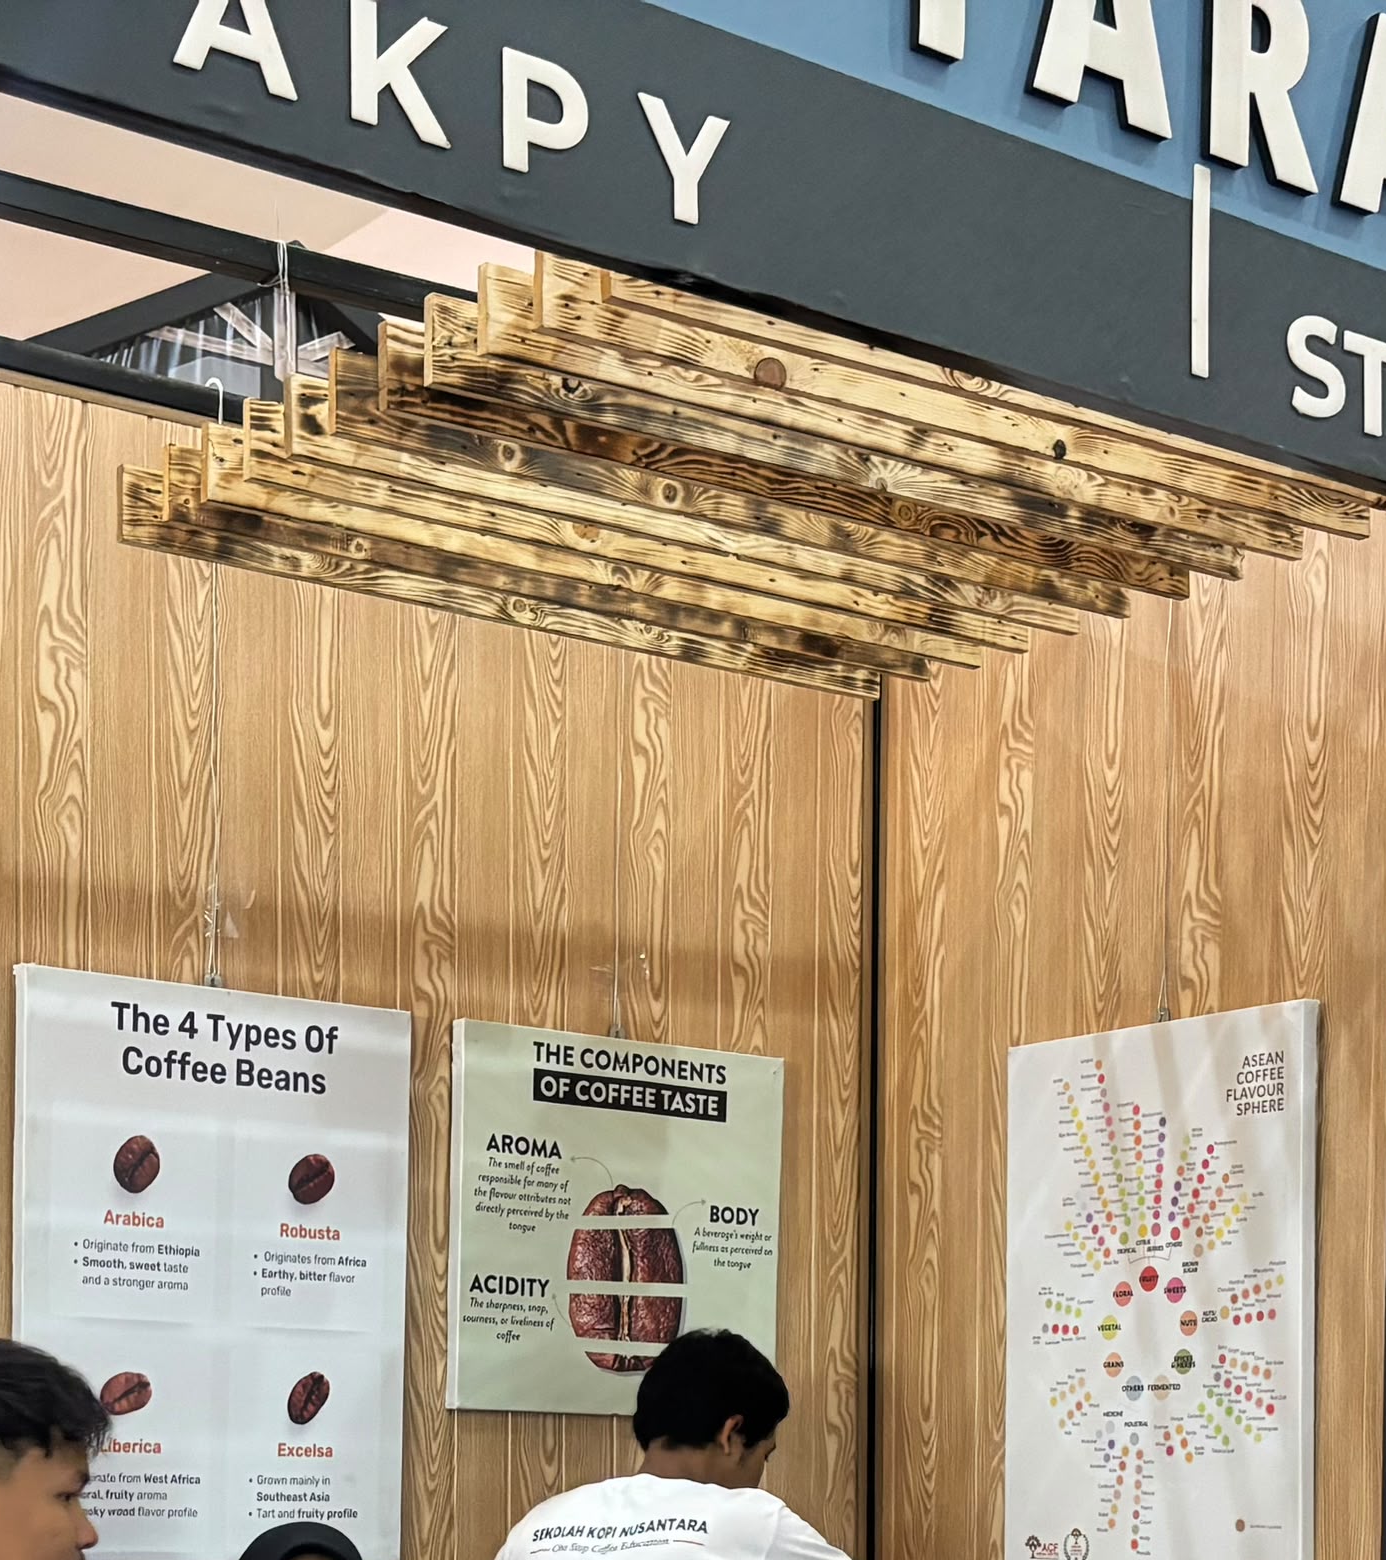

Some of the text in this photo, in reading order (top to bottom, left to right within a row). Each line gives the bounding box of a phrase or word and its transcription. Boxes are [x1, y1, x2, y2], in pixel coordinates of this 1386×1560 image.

[173, 0, 731, 225] AKPY
[111, 1001, 338, 1054] The 4 Types Of
[533, 1041, 726, 1085] THE COMPONENTS
[1242, 1050, 1284, 1069] ASEAN
[122, 1046, 326, 1095] Coffee Beans
[1236, 1066, 1284, 1085] COFFEE
[540, 1076, 719, 1116] OF COFFEE TASTE
[1226, 1082, 1284, 1102] FLAVOUR
[1236, 1097, 1284, 1116] SPHERE
[486, 1133, 562, 1159] AROMA
[489, 1156, 560, 1177] The smell of coffee
[478, 1174, 569, 1193] responsible for many of
[474, 1186, 571, 1206] the flavour attributes not
[104, 1209, 164, 1228] Arabica
[475, 1201, 569, 1222] directly perceived by the
[710, 1205, 759, 1226] BODY
[280, 1223, 340, 1240] Robusta
[509, 1222, 536, 1234] tongue
[694, 1227, 701, 1236] A
[740, 1231, 763, 1243] weight
[83, 1238, 200, 1258] Originate from Ethiopia
[692, 1240, 719, 1253] fullness
[730, 1246, 763, 1256] perceived
[82, 1256, 189, 1273] Smooth, sweet taste
[264, 1251, 367, 1267] Originates from Africa
[714, 1257, 752, 1271] the tongue
[82, 1275, 188, 1291] and a stronger aroma
[262, 1268, 355, 1283] Earthy, bitter flavor
[261, 1285, 291, 1297] profile
[469, 1274, 550, 1298] ACIDITY
[470, 1297, 548, 1316] The sharpness, snap,
[463, 1315, 498, 1325] sourness,
[546, 1317, 555, 1331] of
[496, 1330, 521, 1343] coffee
[278, 1443, 333, 1458] Excelsa
[118, 1472, 141, 1483] from
[144, 1473, 168, 1484] West
[170, 1474, 200, 1484] Africa
[257, 1474, 330, 1488] Grown mainly in
[106, 1489, 167, 1502] fruity aroma
[256, 1492, 330, 1502] Southeast Asia
[107, 1506, 198, 1519] wood flavor profile
[257, 1508, 358, 1521] Tart and fruity profile
[532, 1518, 708, 1542] SEKOLAH KOPI NUSANTARA
